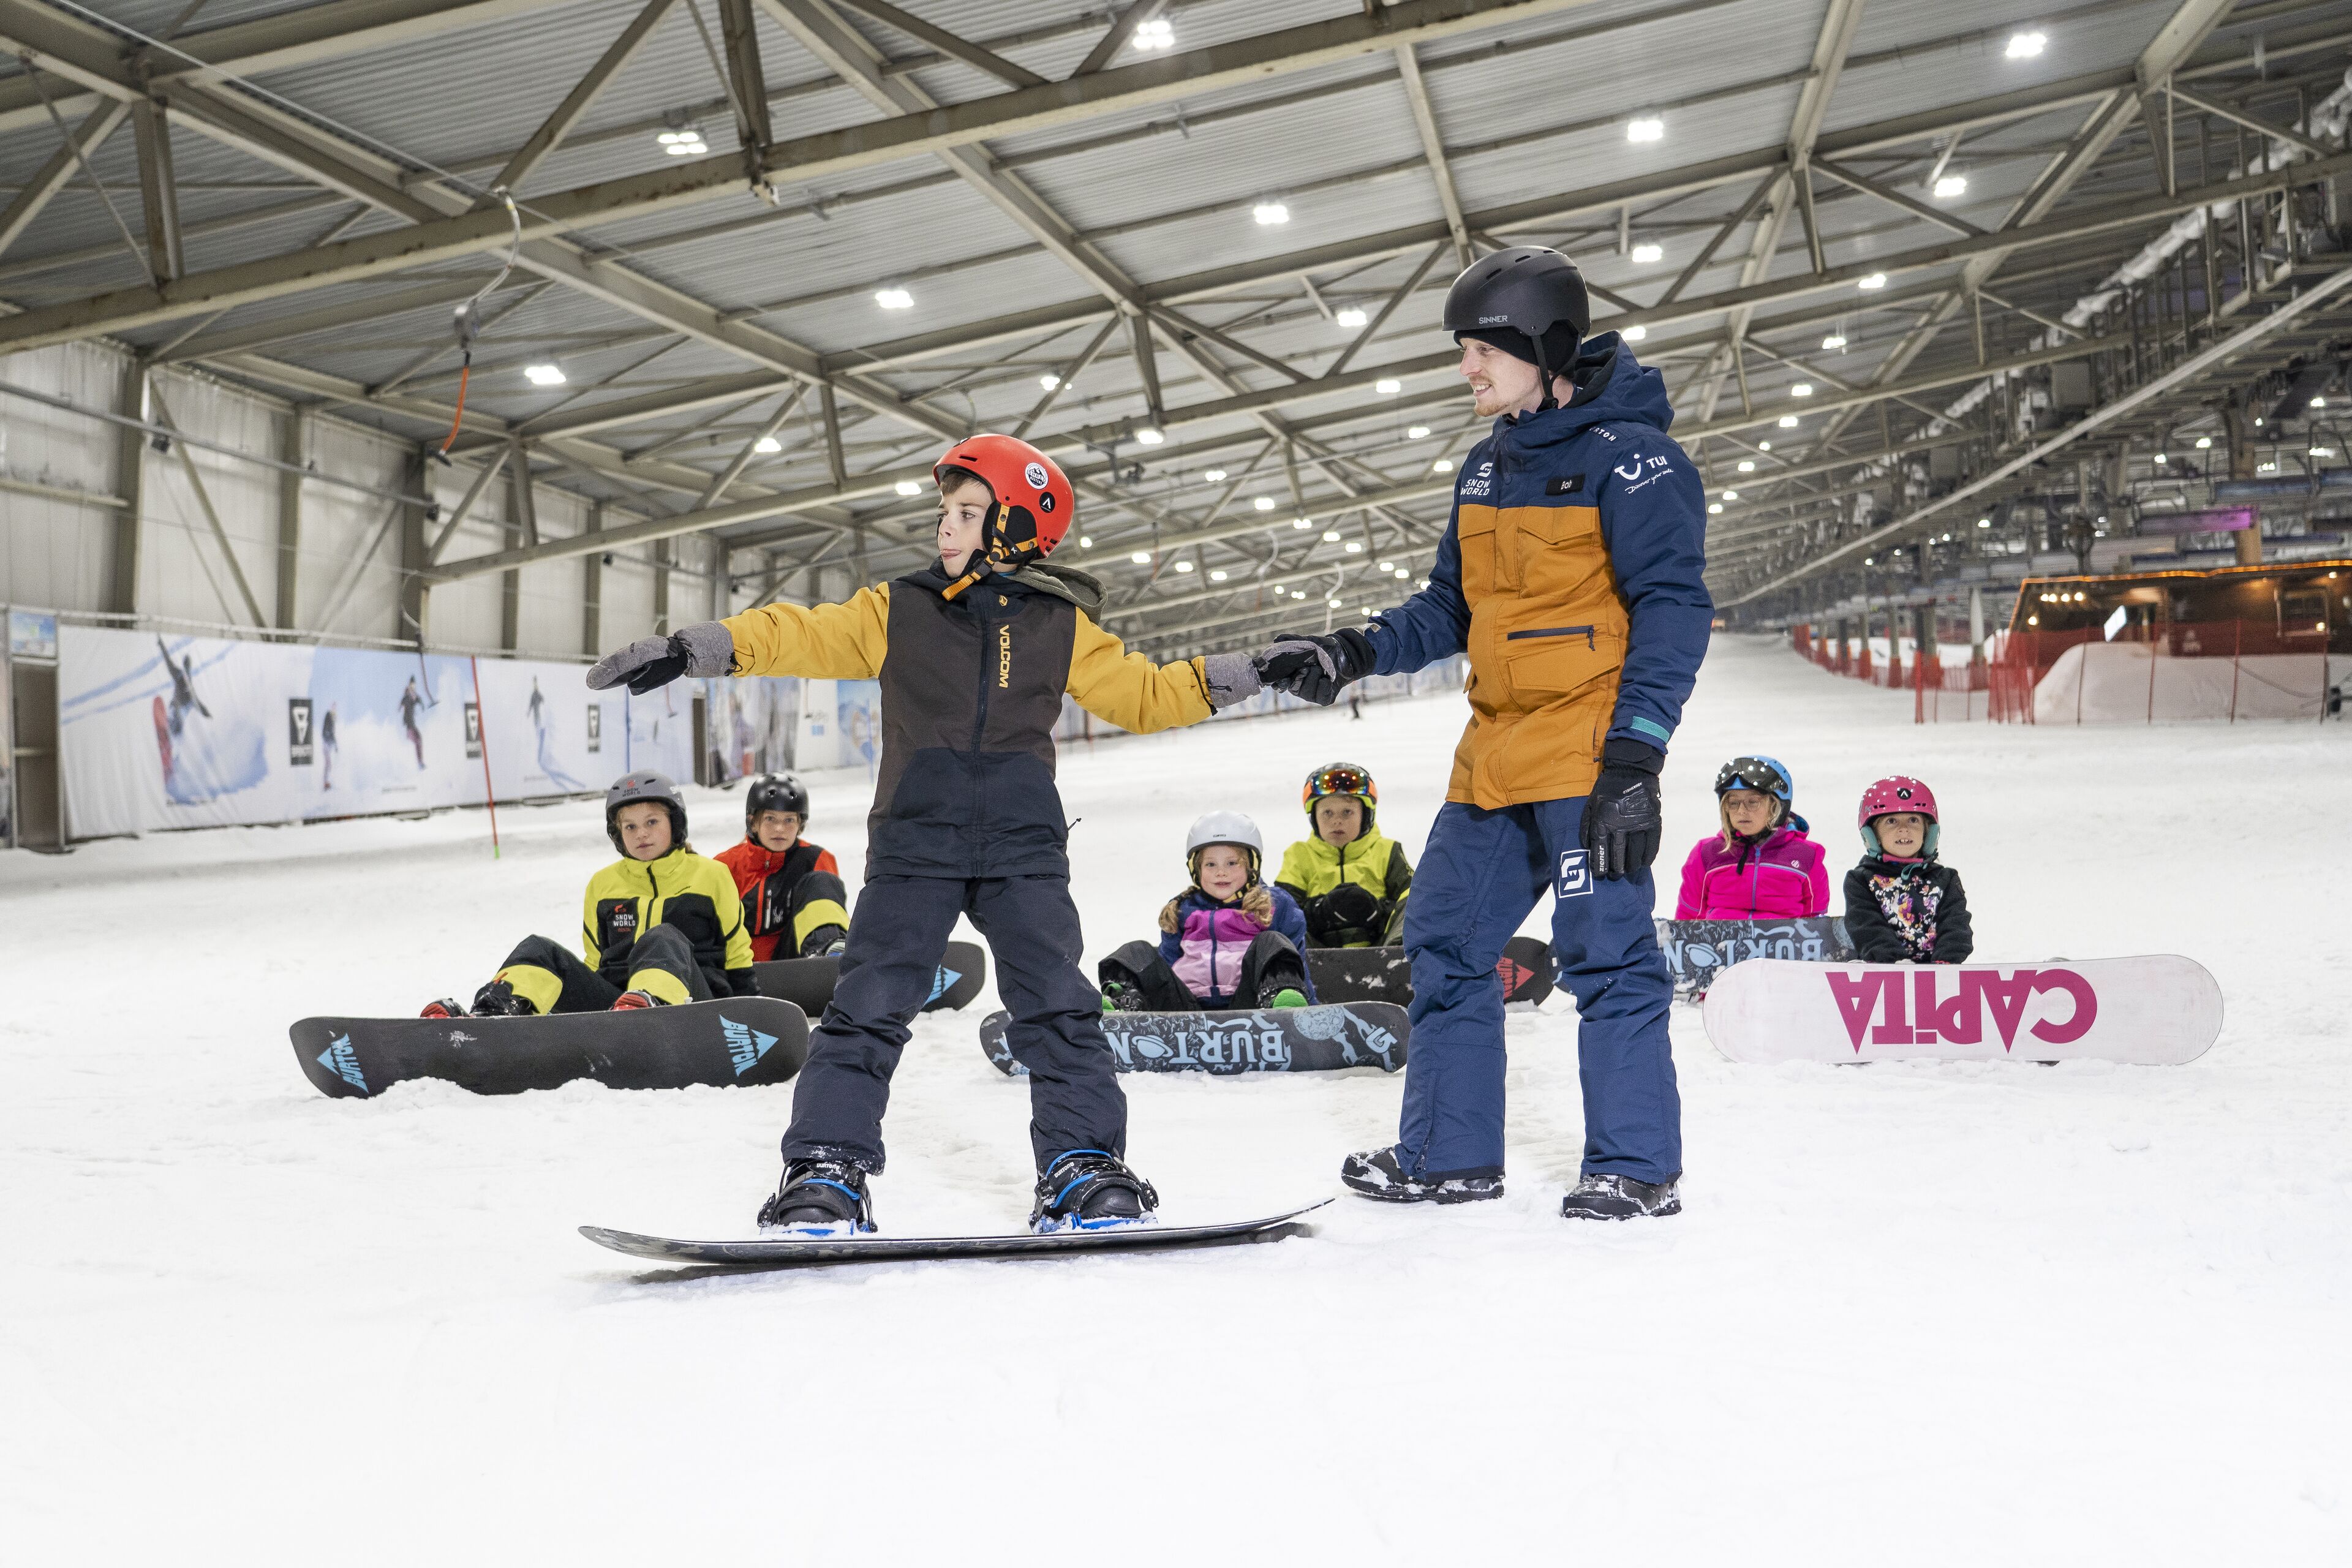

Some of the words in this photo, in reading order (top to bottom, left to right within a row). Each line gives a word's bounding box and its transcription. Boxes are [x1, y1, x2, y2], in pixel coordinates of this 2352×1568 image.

[1479, 315, 1508, 325] SINNER
[1589, 426, 1616, 442] RTON
[1646, 455, 1668, 469] TUI
[1465, 479, 1491, 488] SNOW
[1561, 480, 1572, 490] Bob
[1624, 478, 1651, 494] Discover
[1651, 472, 1662, 484] your
[1460, 487, 1490, 496] WORLD
[999, 624, 1011, 688] VOLCOM
[719, 1014, 758, 1077] BURTON
[1104, 1030, 1287, 1065] BURTON
[331, 1033, 369, 1094] BURTON
